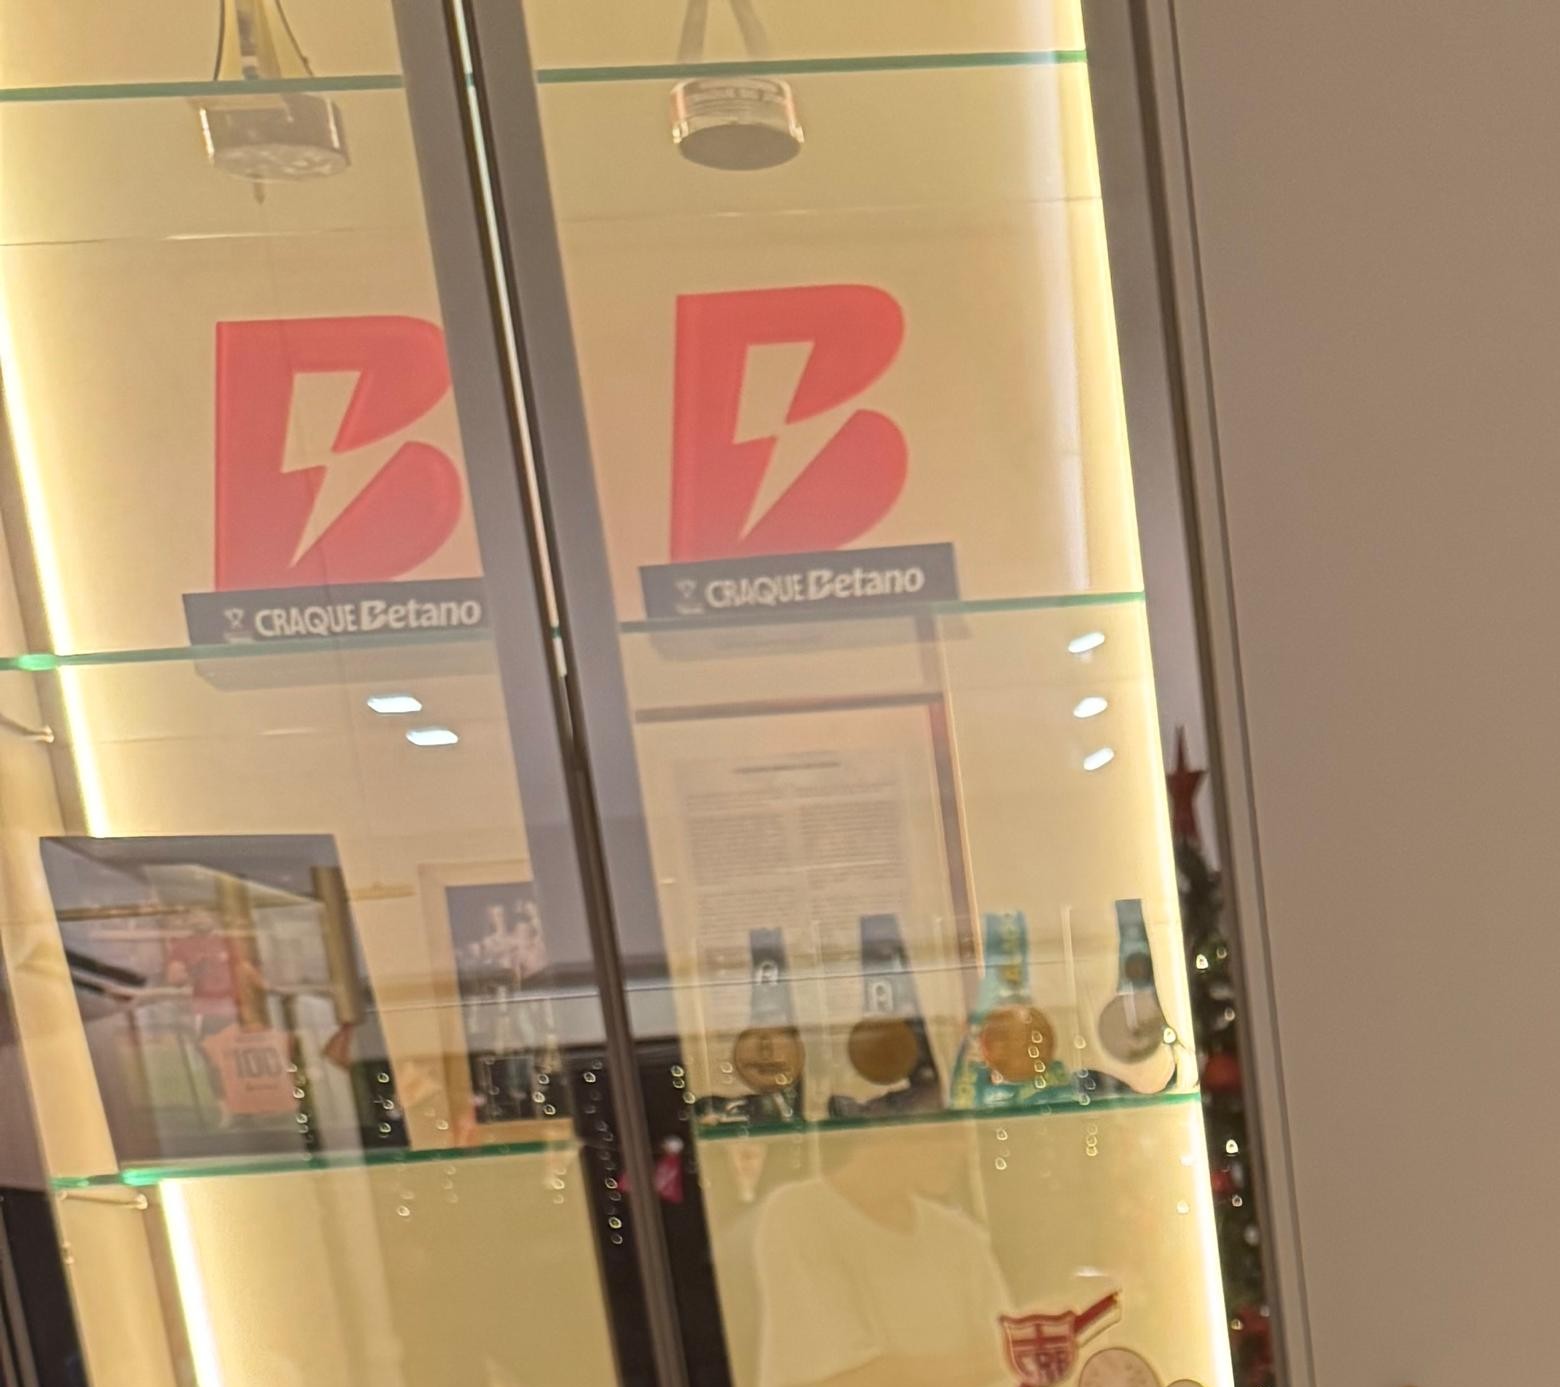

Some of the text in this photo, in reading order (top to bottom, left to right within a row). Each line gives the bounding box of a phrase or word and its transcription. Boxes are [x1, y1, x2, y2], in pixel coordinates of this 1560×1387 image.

[705, 565, 925, 608] CRAQUE Betano
[254, 598, 482, 638] CRAQUE Betano
